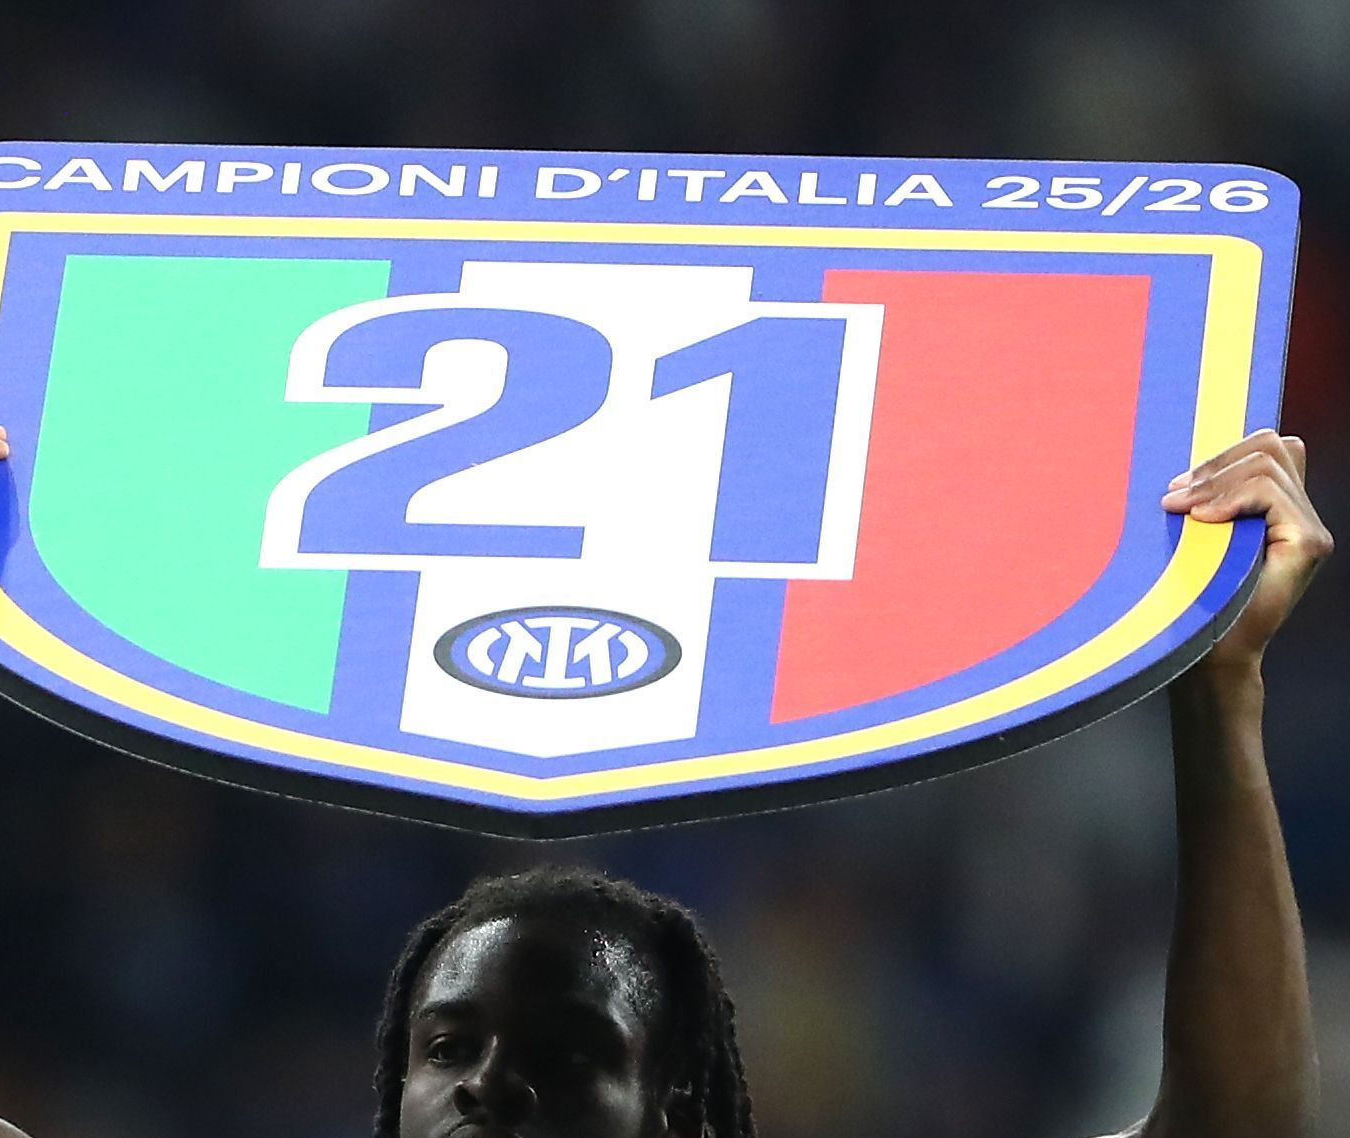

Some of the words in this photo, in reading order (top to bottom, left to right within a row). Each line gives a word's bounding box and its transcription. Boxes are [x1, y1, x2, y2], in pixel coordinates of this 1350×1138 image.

[533, 165, 955, 209] D'ITALIA
[979, 174, 1272, 218] 25/26
[296, 306, 848, 565] 21
